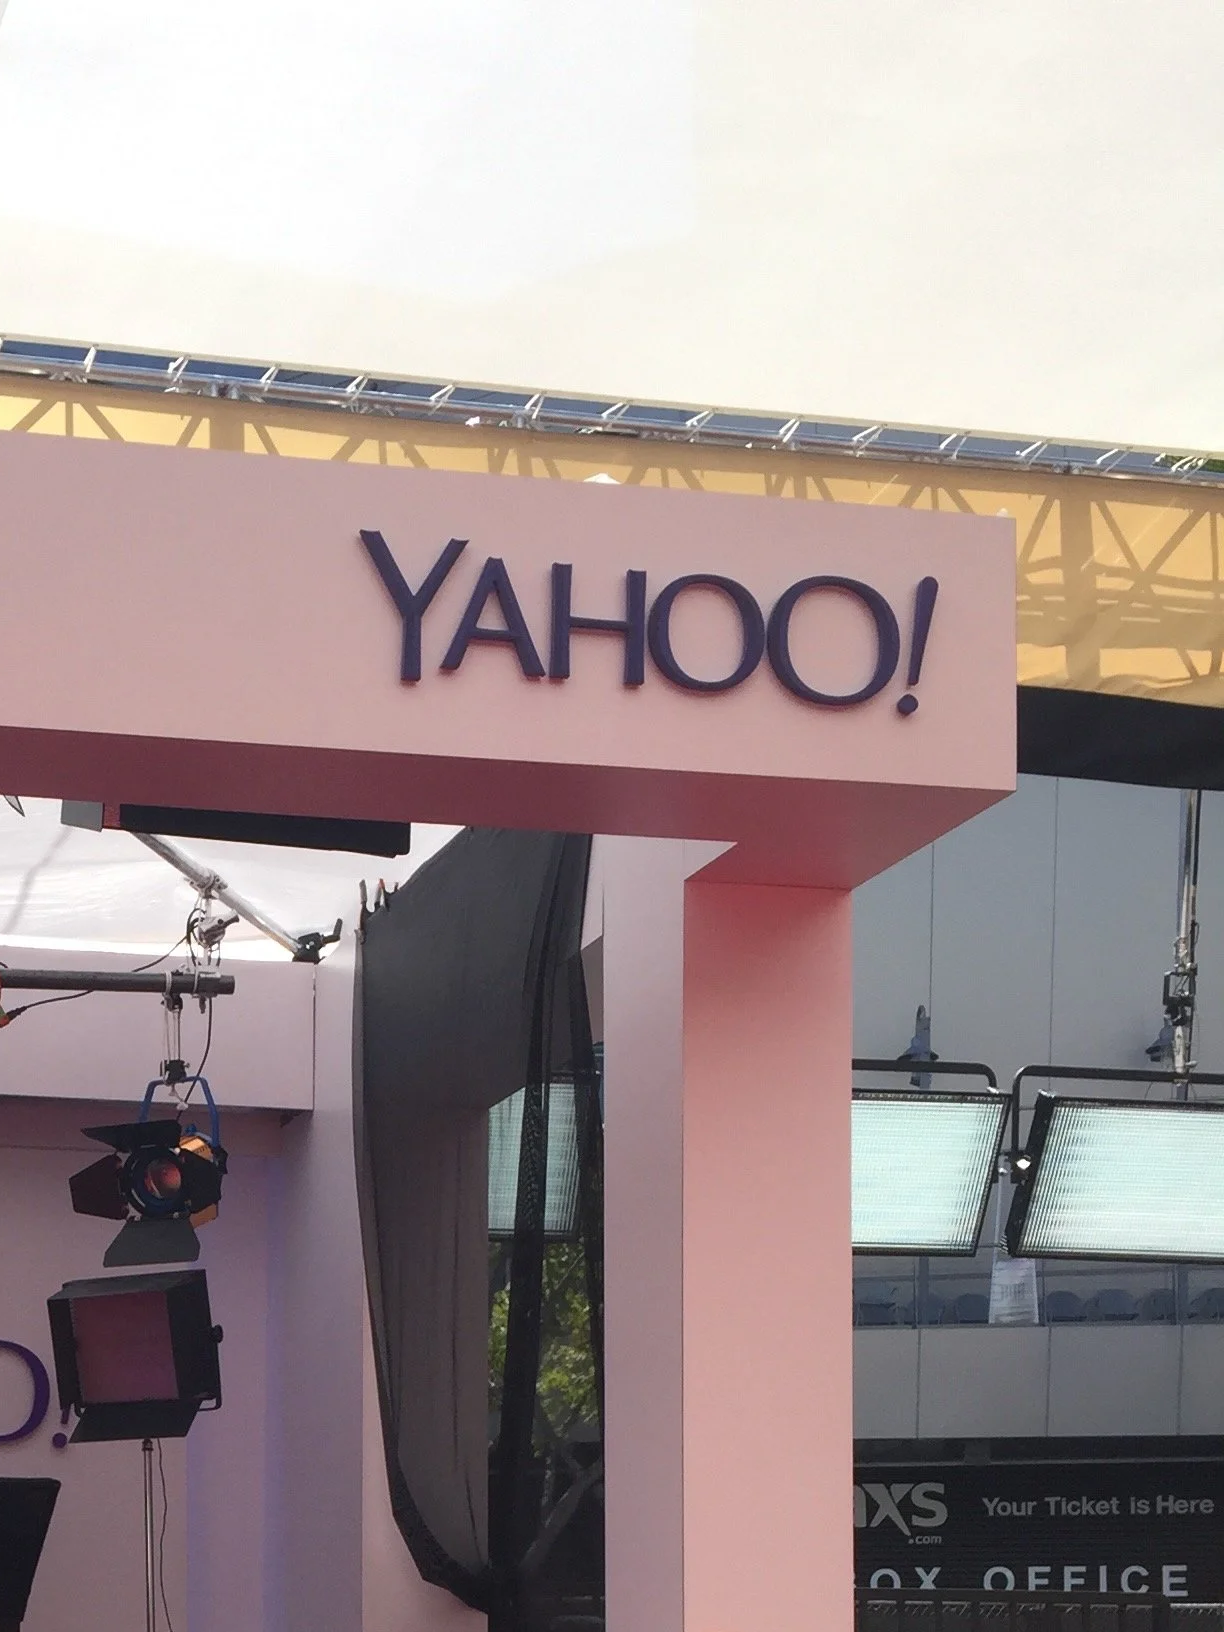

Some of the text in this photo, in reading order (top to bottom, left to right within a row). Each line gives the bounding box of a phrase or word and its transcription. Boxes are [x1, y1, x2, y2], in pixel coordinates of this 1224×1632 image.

[359, 528, 939, 716] YAHOO!
[982, 1497, 1037, 1516] Your
[1044, 1496, 1121, 1516] Ticket
[1156, 1495, 1215, 1515] Here
[855, 1564, 1189, 1597] OX OFFICE
